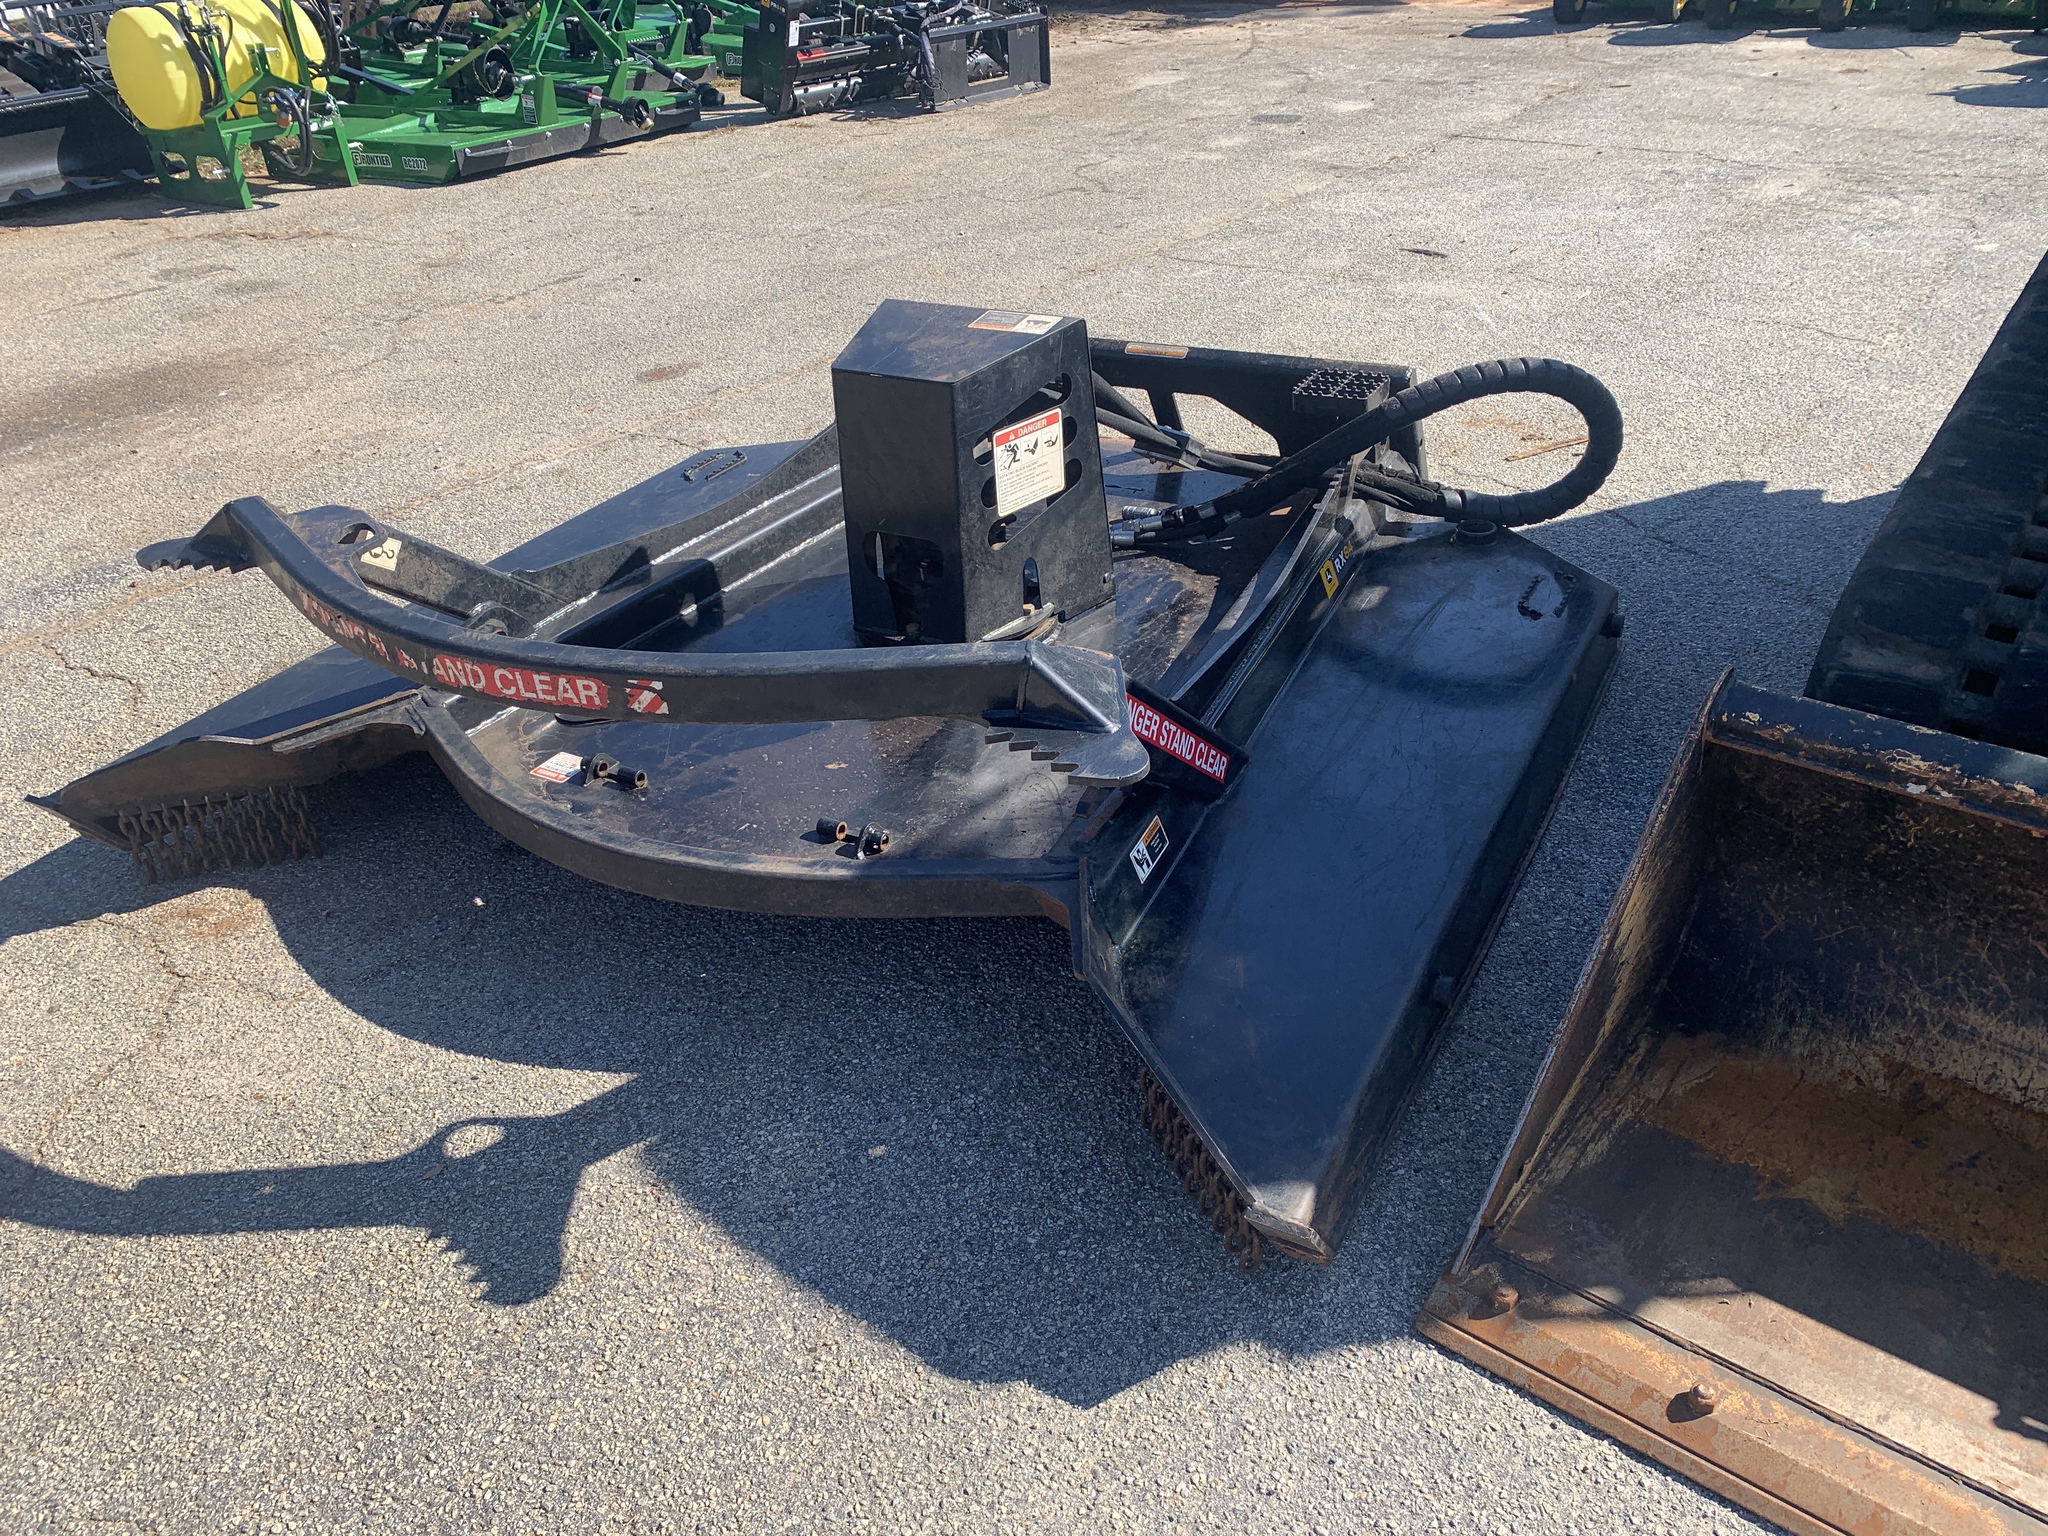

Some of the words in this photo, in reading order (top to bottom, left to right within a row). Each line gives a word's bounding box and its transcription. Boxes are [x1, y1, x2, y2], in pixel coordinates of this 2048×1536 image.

[353, 151, 392, 168] FRONTIER
[1018, 418, 1048, 437] DANGER
[1334, 540, 1354, 573] RX84
[494, 668, 601, 705] CLEAR
[1127, 699, 1160, 741] NGER
[1159, 720, 1196, 761] STAND
[1195, 742, 1228, 780] CLEAR
